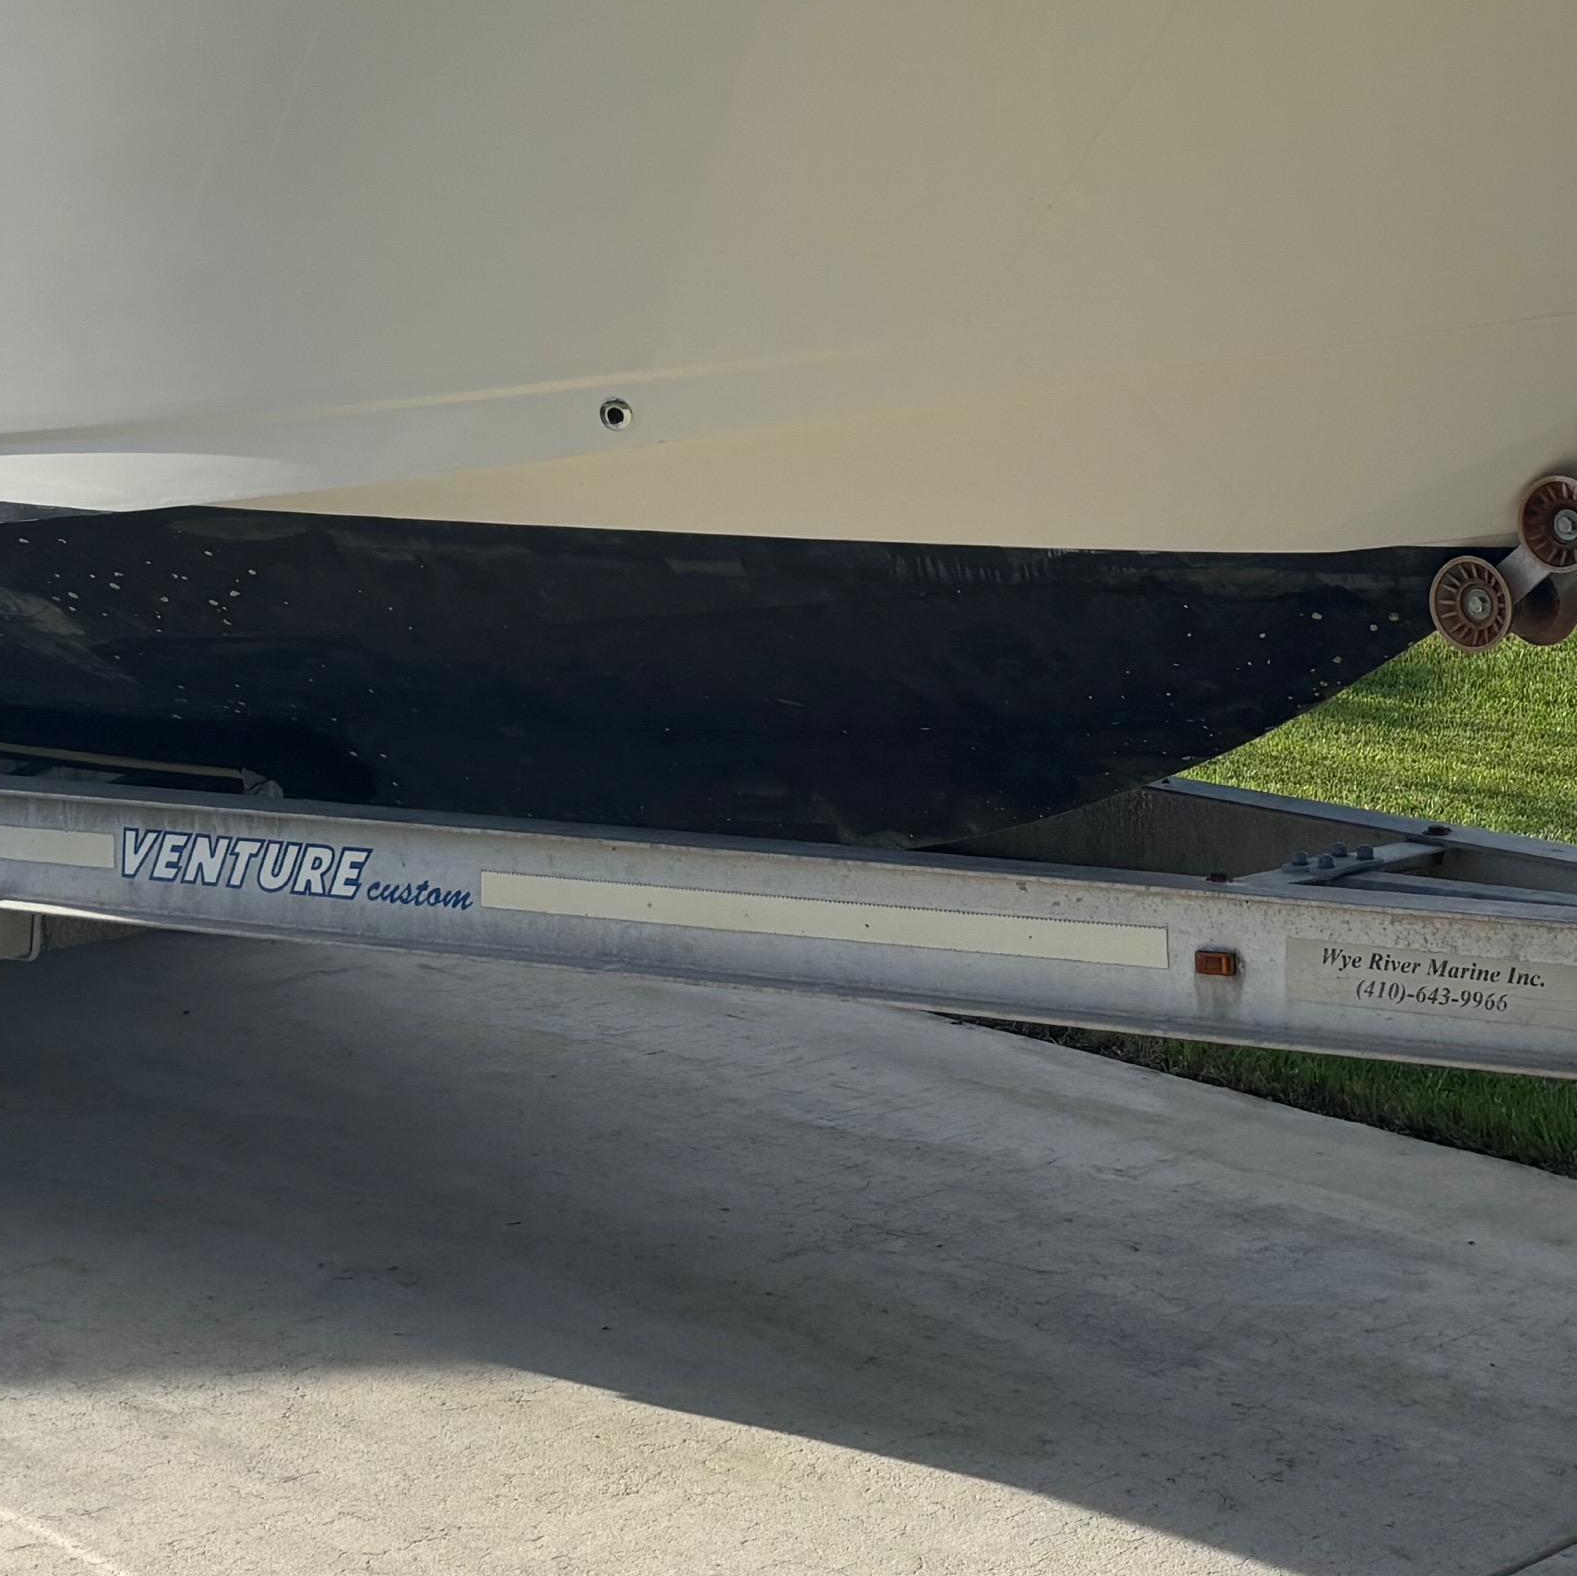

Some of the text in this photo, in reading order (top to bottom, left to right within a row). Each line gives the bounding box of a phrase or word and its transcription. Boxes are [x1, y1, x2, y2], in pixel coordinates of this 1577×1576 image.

[122, 827, 473, 910] VENTURE custom
[1322, 947, 1546, 988] Wye River Marine Inc.
[1355, 979, 1508, 1012] (410)-643-9966
